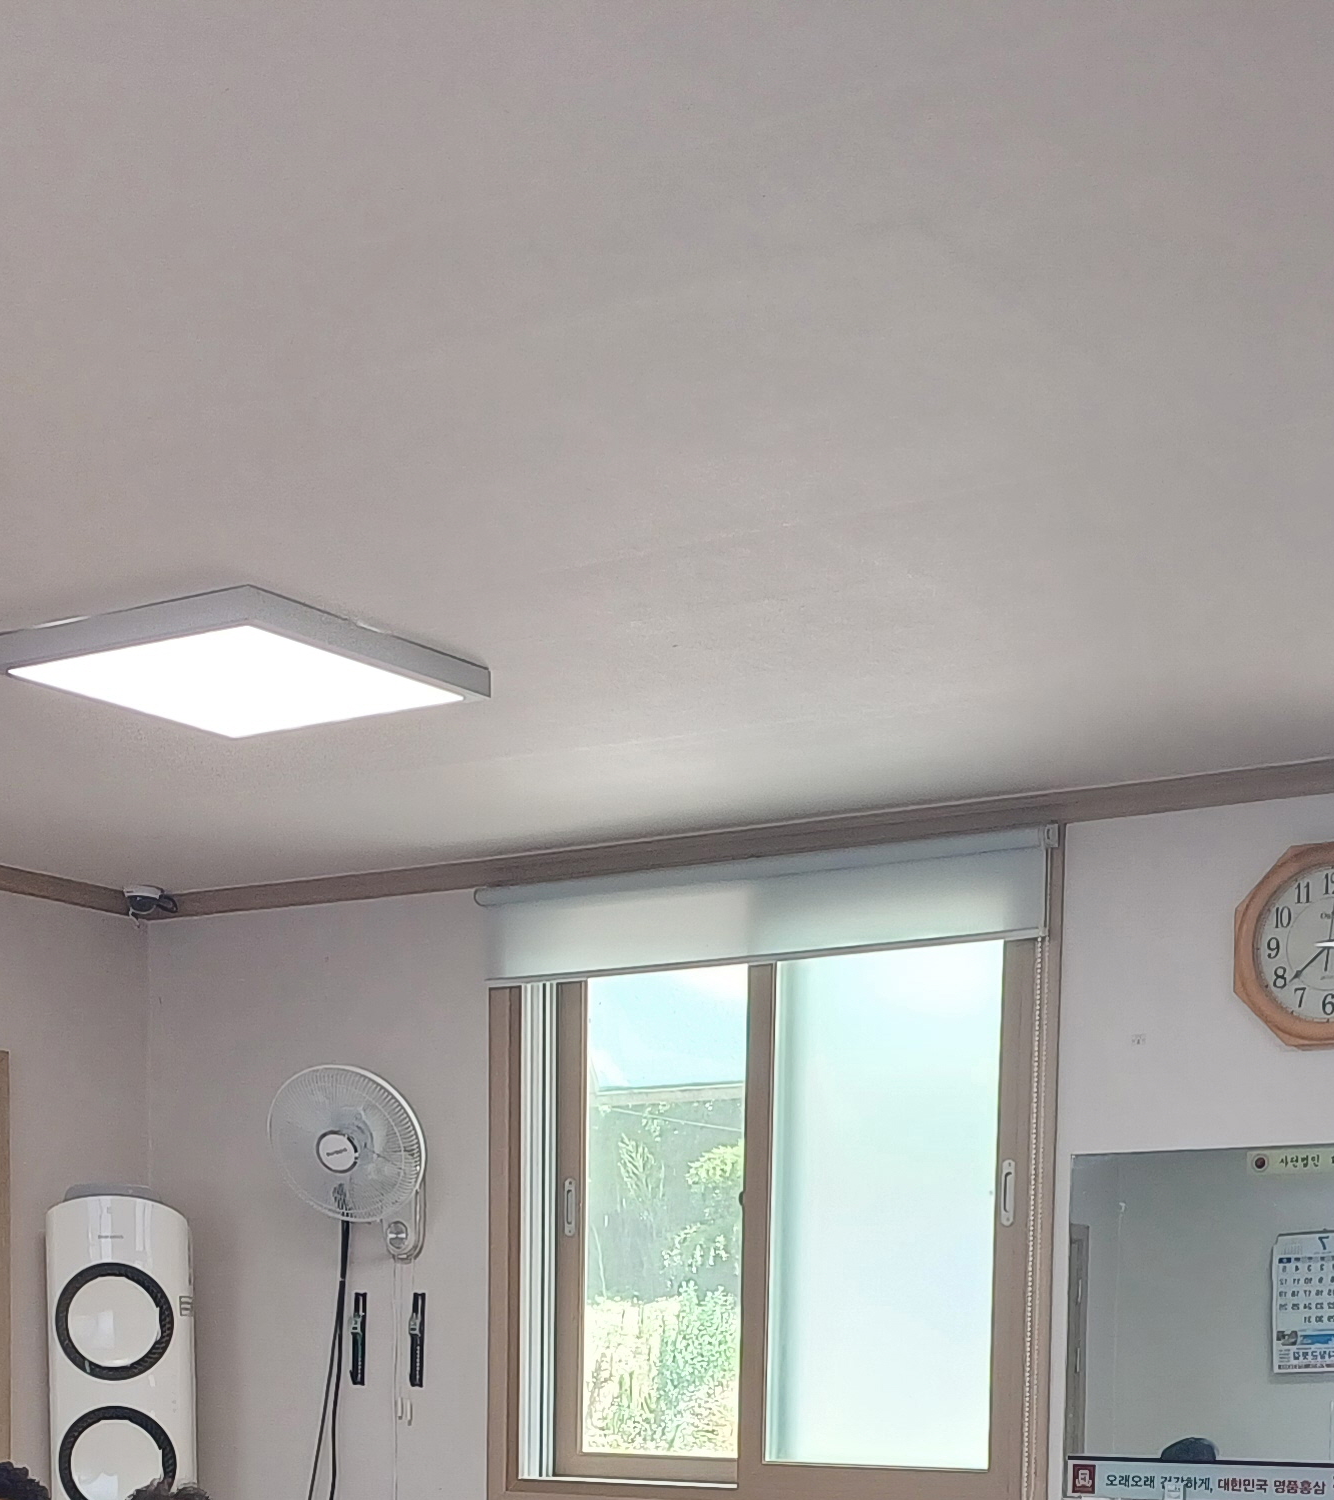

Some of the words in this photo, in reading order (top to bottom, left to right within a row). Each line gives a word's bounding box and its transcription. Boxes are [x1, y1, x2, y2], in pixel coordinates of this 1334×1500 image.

[1295, 882, 1311, 903] 11
[1275, 906, 1291, 928] 10
[1267, 937, 1279, 959] 9
[1273, 966, 1287, 988] 8
[1294, 987, 1306, 1008] 7
[1322, 993, 1334, 1015] 6
[1279, 1155, 1320, 1168] 사단법인
[1106, 1475, 1155, 1489] 오래오래
[1217, 1478, 1268, 1492] 대한민국
[1274, 1480, 1326, 1495] 명품홍삼
